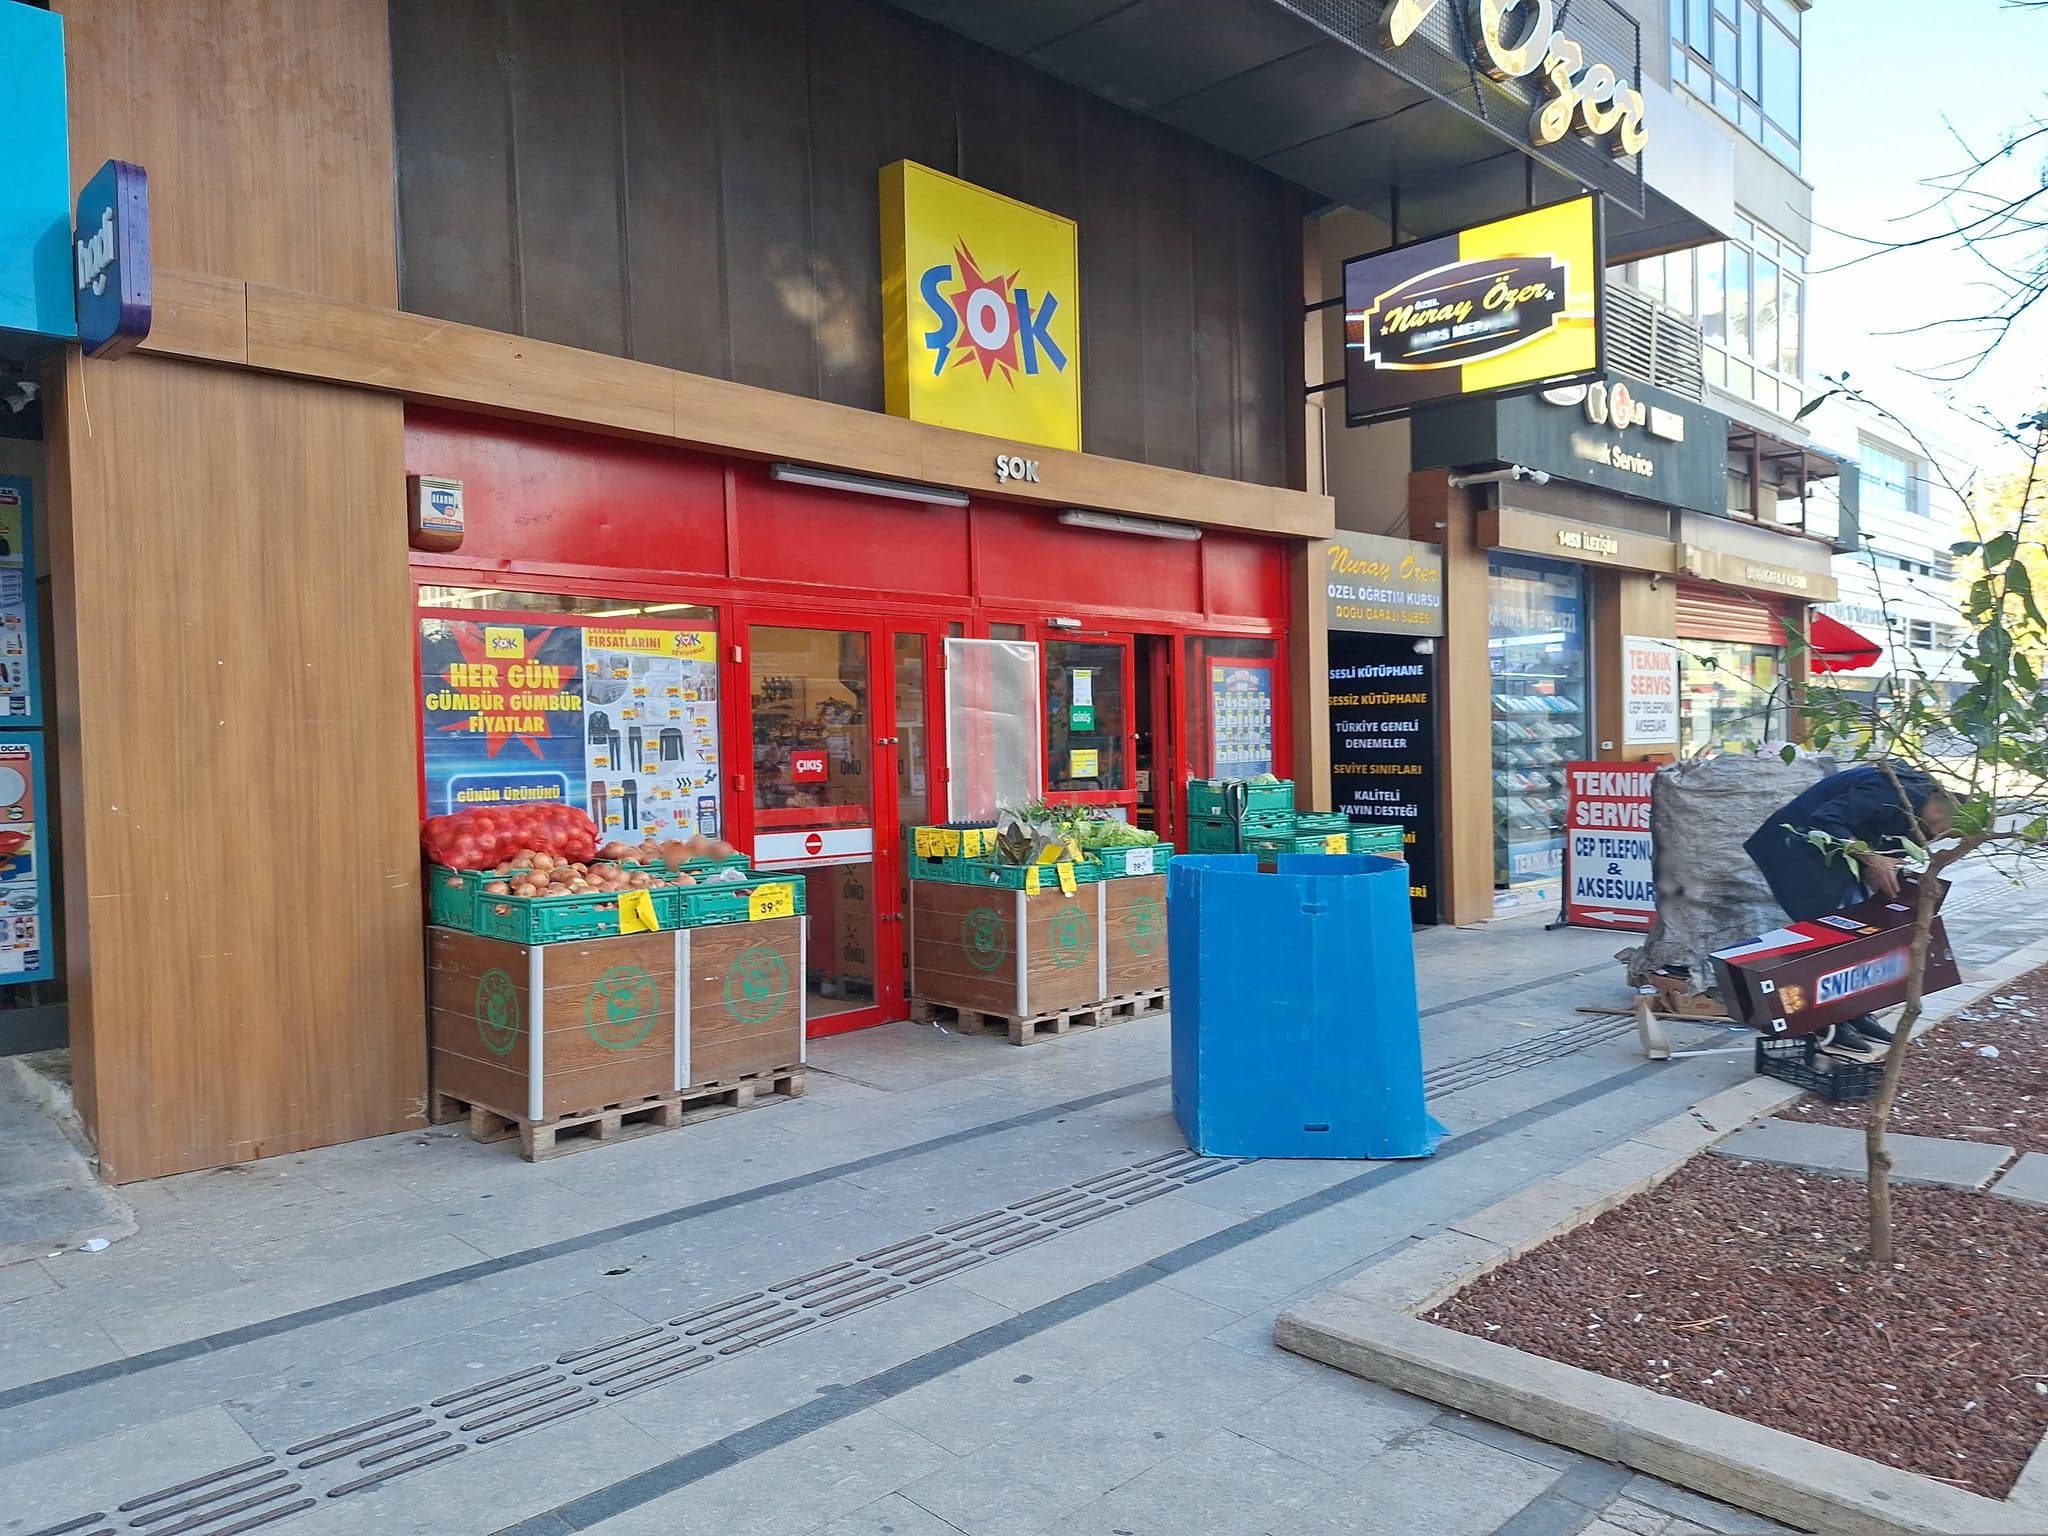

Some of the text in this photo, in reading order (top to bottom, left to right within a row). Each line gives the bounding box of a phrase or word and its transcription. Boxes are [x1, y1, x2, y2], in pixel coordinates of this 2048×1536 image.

[1384, 275, 1548, 333] Nuray Özer
[919, 265, 1068, 377] ŞOK
[996, 454, 1040, 483] ŞOK
[1612, 445, 1654, 477] Service
[1328, 544, 1392, 584] Nuray
[1407, 591, 1441, 608] KURSU
[588, 636, 662, 649] FIRSATLARINI
[450, 659, 560, 689] HER GÜN
[1329, 664, 1424, 679] SESLİ KÜTÜPHANE
[425, 689, 582, 711] GÜMBÜR GÜMBÜR
[1361, 692, 1428, 705] KÜTÜPHANE
[469, 711, 545, 733] FİYATLAR
[1336, 719, 1419, 732] TÜRKİYE GENELİ
[1345, 738, 1407, 749] DENEMELER
[796, 759, 823, 773] ÇIKIŞ
[1333, 762, 1422, 775] SEVİYE SINIFLARI
[457, 787, 500, 803] GÜNÜN
[1354, 788, 1400, 801] KALİTELİ
[1339, 804, 1418, 816] YAYIN DESTEĞİ
[1575, 836, 1595, 857] CEP
[1607, 862, 1622, 875] &
[760, 902, 773, 914] 39
